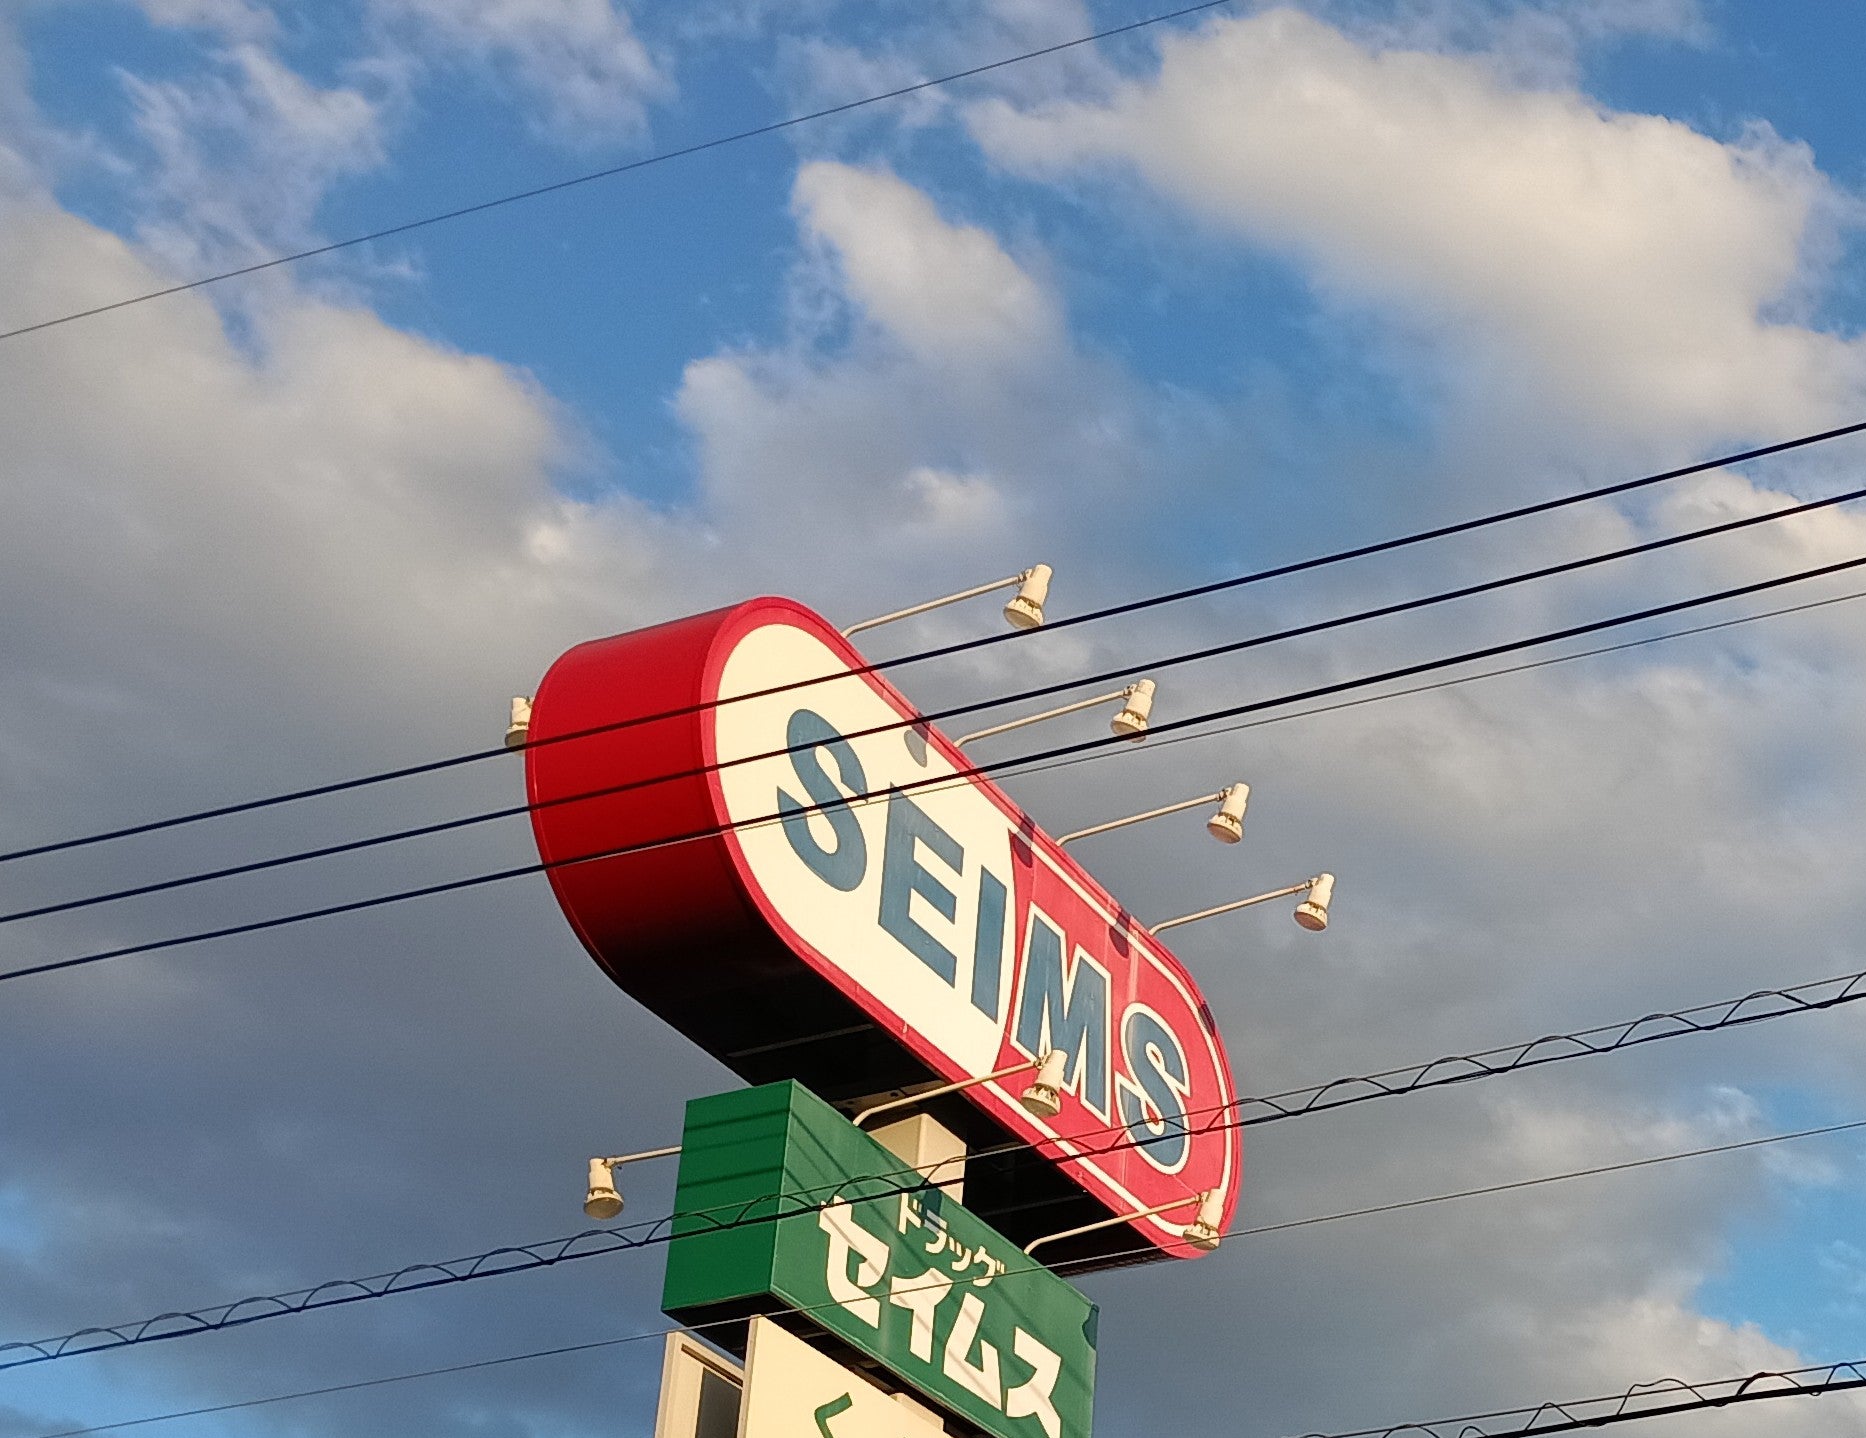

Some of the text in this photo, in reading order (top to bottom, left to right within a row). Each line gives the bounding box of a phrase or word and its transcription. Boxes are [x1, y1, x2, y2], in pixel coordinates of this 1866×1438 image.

[776, 707, 1192, 1174] SEIMS
[897, 1190, 1006, 1287] ドラッグ
